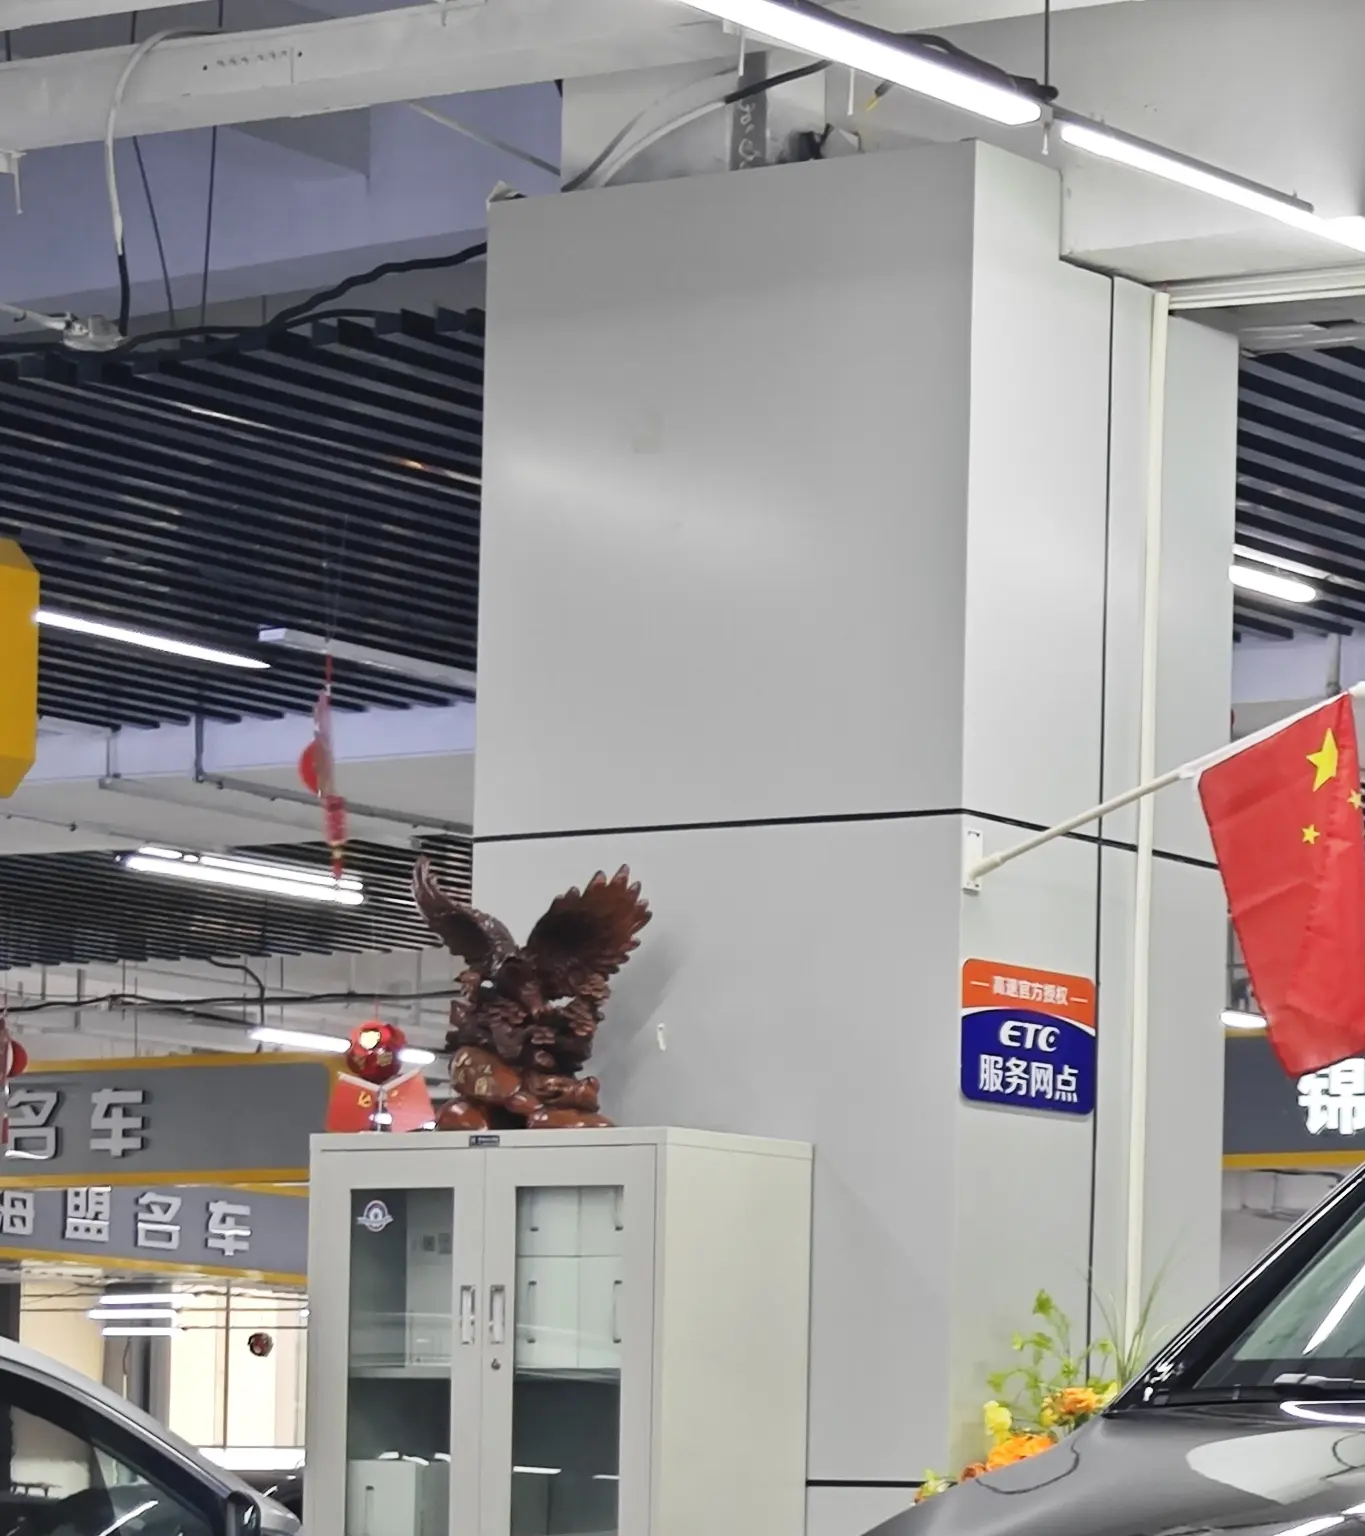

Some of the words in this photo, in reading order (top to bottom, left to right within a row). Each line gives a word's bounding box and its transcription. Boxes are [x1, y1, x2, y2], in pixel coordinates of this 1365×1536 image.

[993, 975, 1069, 1006] 高速官方授权
[999, 1020, 1061, 1052] ETC
[979, 1054, 1079, 1102] 服务网点
[5, 1087, 144, 1160] 名车
